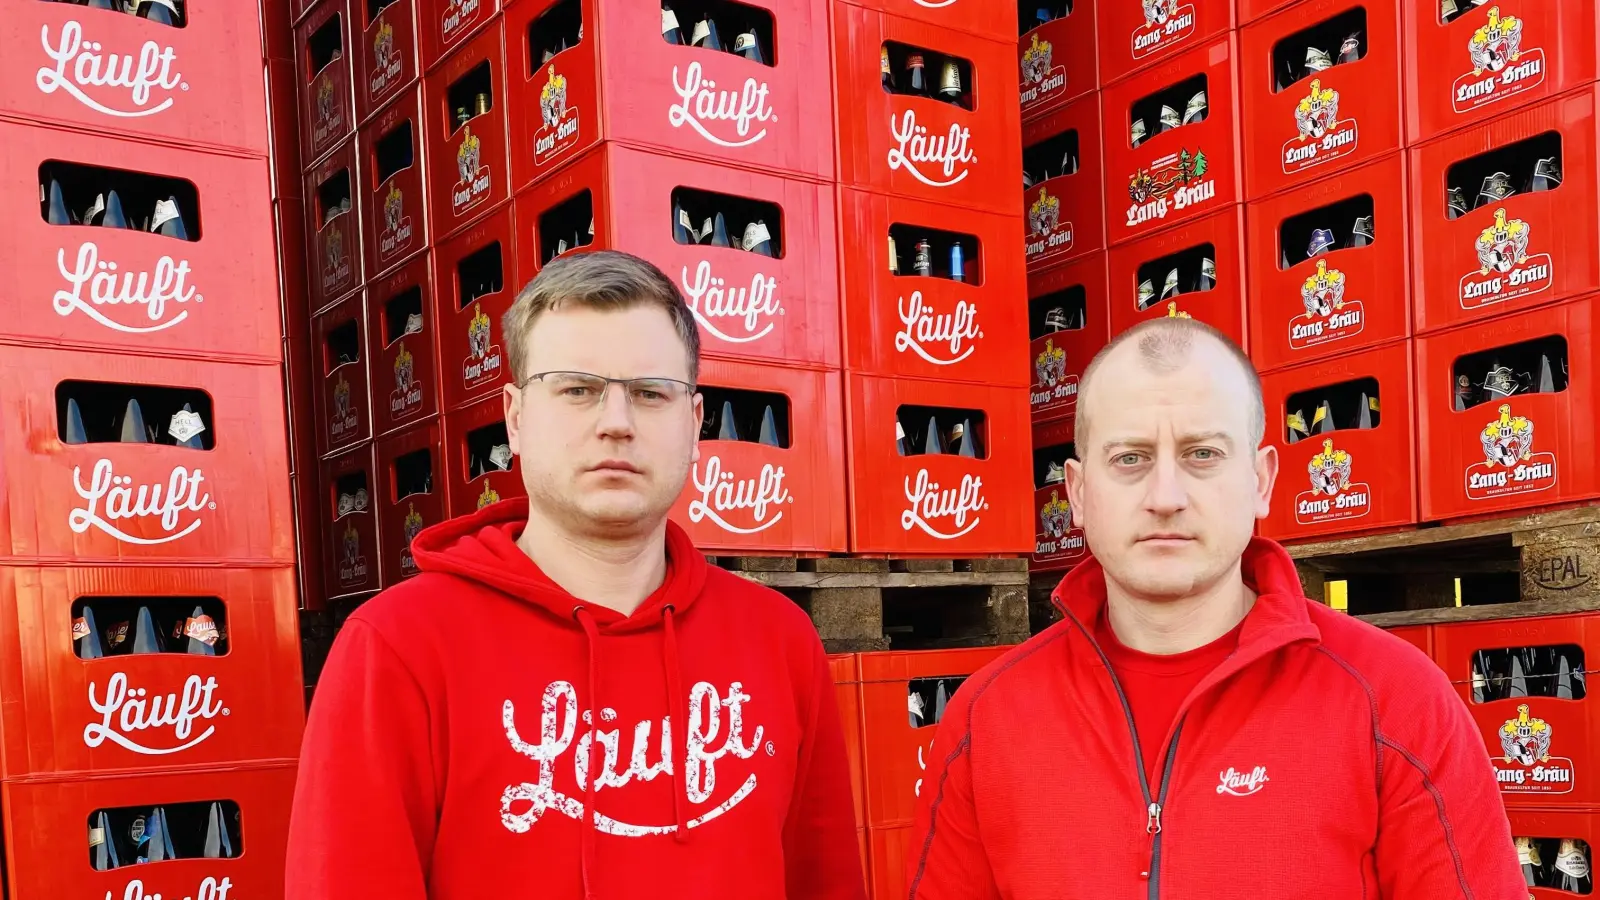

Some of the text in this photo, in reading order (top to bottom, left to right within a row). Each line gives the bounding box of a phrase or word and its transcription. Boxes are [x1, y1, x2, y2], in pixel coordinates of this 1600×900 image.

[1134, 13, 1193, 50] Lang-Bräu
[1019, 73, 1064, 103] ang-Bräu
[1455, 58, 1541, 102] Lang-Bräu
[536, 115, 578, 155] Lang-Bräu
[1284, 127, 1355, 164] Lang-Bräu
[1126, 179, 1216, 227] Lang-Bräu
[1463, 263, 1548, 299] Lang-Bräu
[1291, 309, 1361, 340] Lang-Bräu
[1030, 382, 1078, 405] Lang-Bräu
[174, 418, 192, 426] HELL
[1469, 461, 1553, 489] Lang-Bräu
[1298, 490, 1367, 515] Lang-Bräu
[1540, 554, 1589, 583] EPAL
